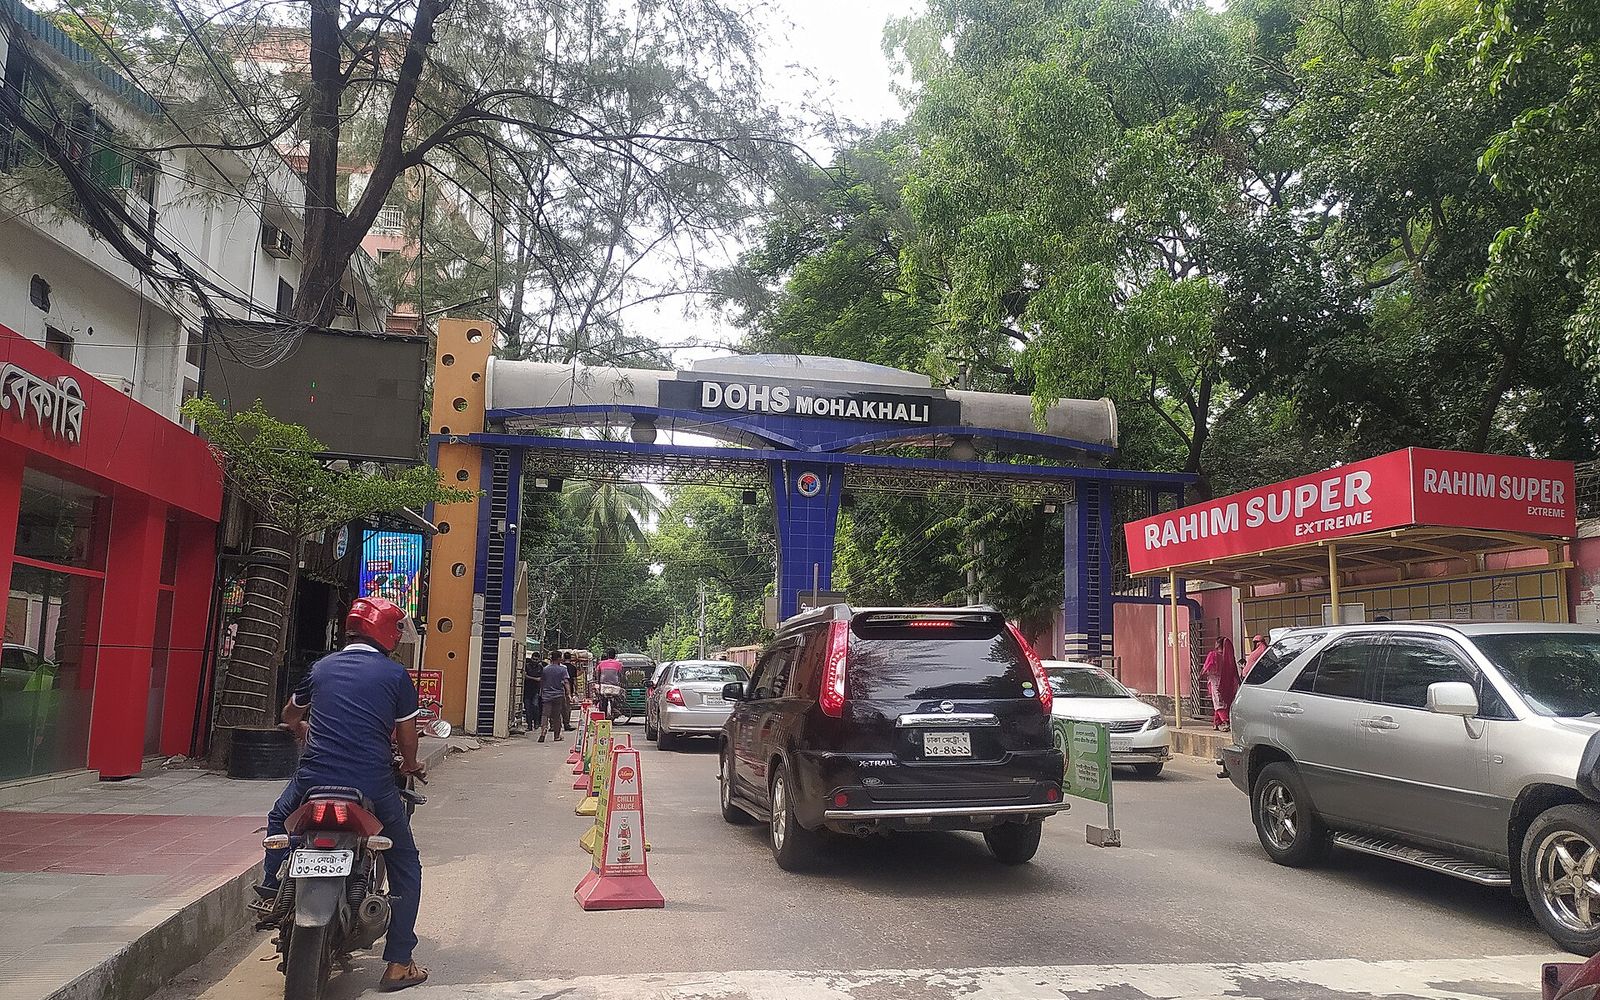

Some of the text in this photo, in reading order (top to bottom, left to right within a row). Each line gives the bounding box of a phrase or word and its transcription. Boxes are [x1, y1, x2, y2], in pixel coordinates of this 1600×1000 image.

[0, 362, 86, 444] বেকারি
[701, 381, 929, 423] DOHS MOHAKHALI
[1423, 468, 1565, 504] RAHIM SUPER
[1144, 470, 1373, 550] RAHIM SUPER
[1527, 506, 1566, 518] EXTREME
[1295, 510, 1373, 536] EXTREME
[926, 736, 941, 744] ঢাকা
[926, 746, 970, 755] ১৫-৪৬২১
[858, 759, 896, 767] X-TRAIL
[616, 795, 635, 803] CHILLI
